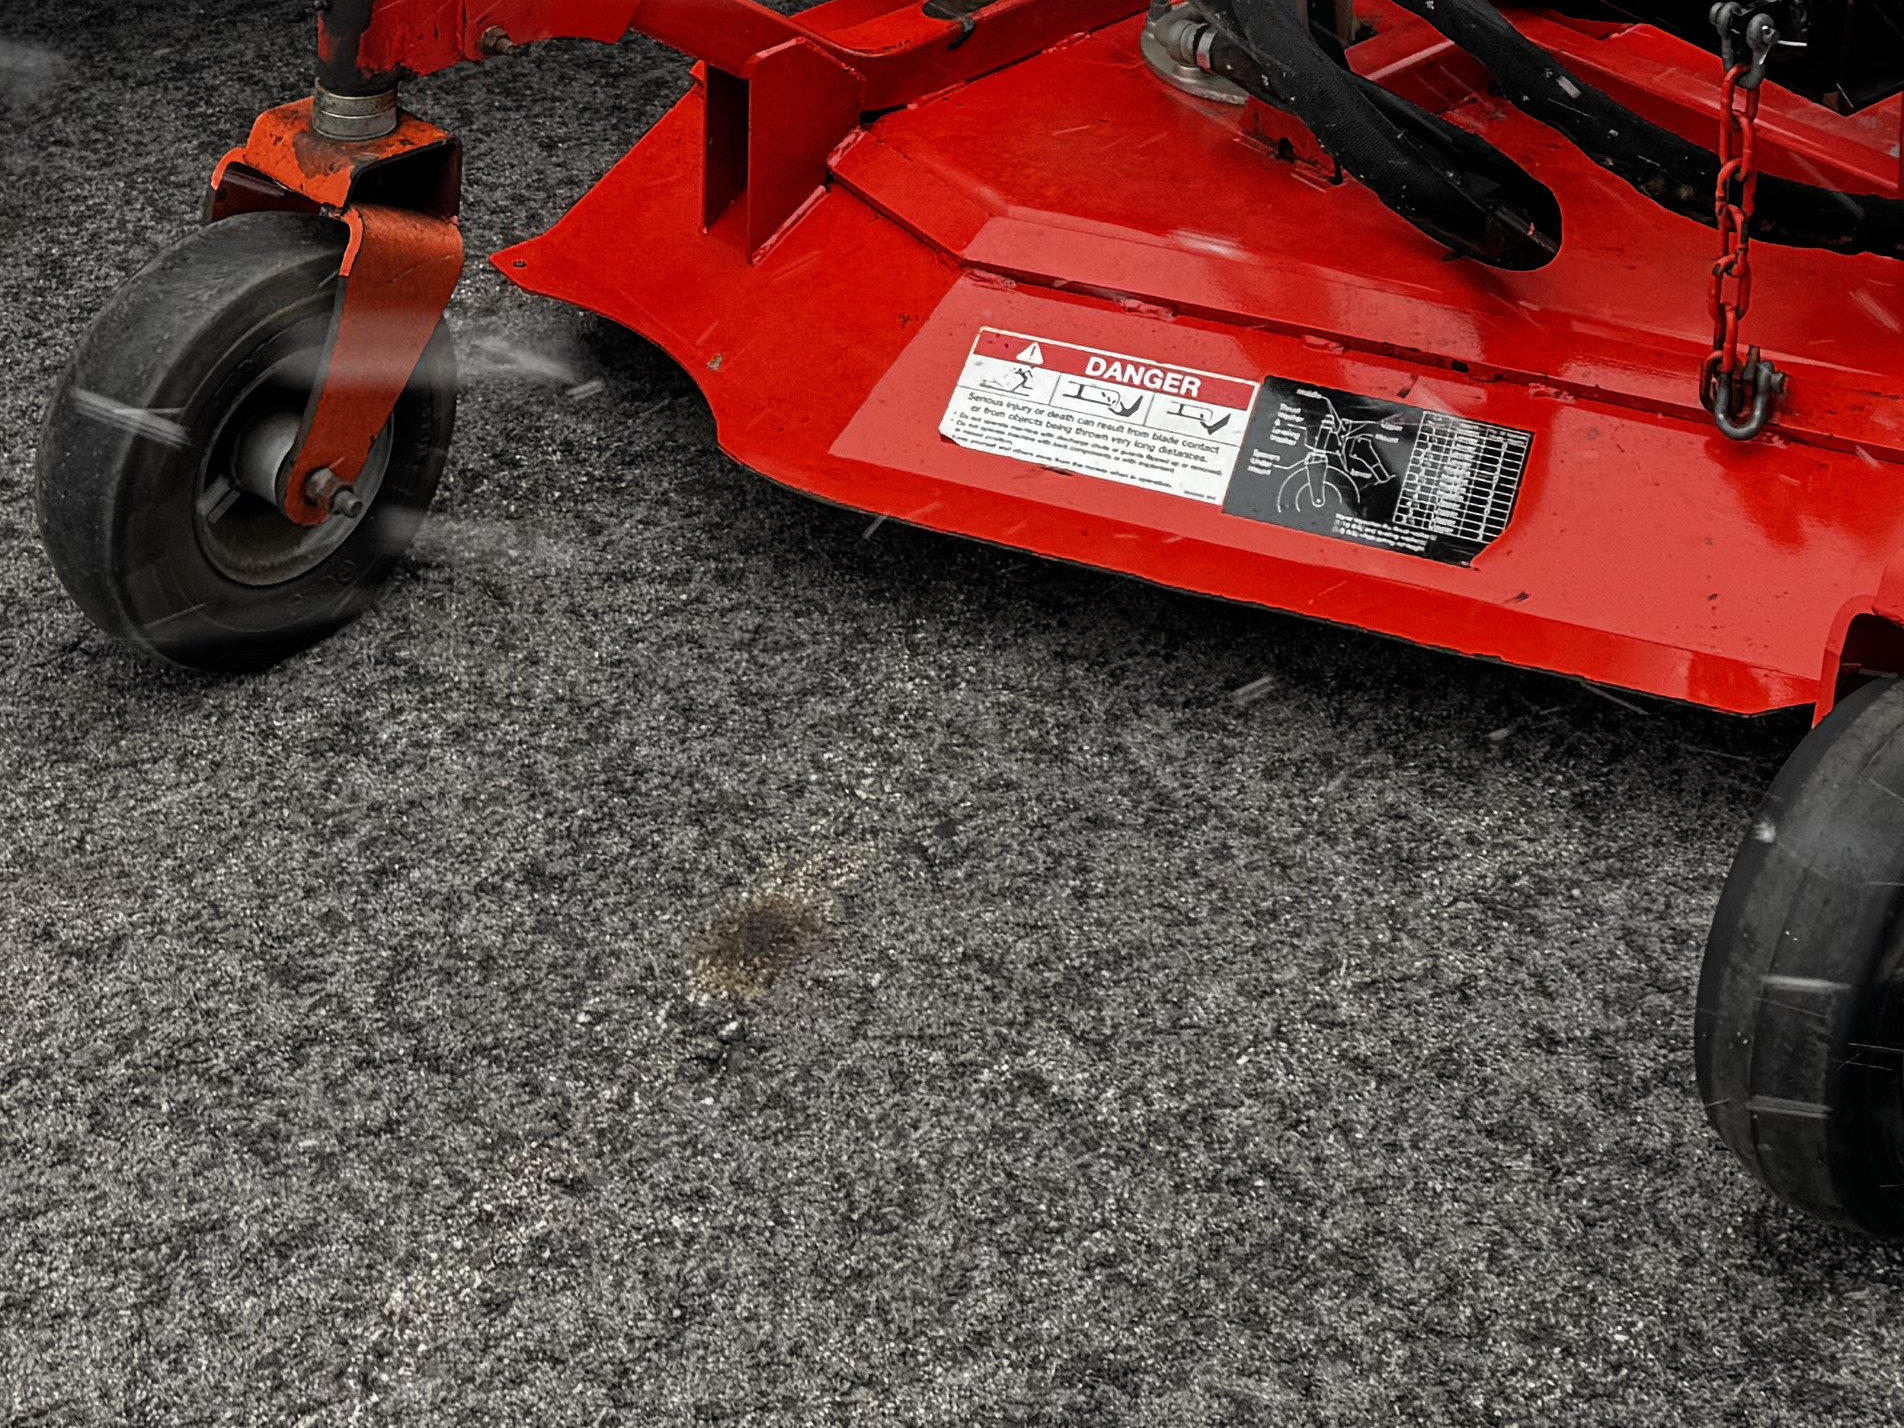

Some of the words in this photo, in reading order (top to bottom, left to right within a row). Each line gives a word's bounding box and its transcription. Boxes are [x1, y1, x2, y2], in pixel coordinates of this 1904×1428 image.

[1085, 355, 1201, 398] DANGER
[967, 392, 1004, 407] Serious
[1005, 401, 1032, 414] injury
[1046, 410, 1074, 422] death
[1076, 417, 1095, 426] can
[1096, 420, 1124, 432] result
[1126, 427, 1150, 438] from
[1151, 432, 1179, 444] blade
[1181, 439, 1220, 454] contact
[970, 404, 981, 412] or
[982, 407, 1006, 418] from
[1007, 412, 1043, 427] objects
[1044, 420, 1073, 434] being
[1074, 427, 1109, 441] thrown
[1110, 435, 1131, 447] very
[1133, 439, 1156, 452] long
